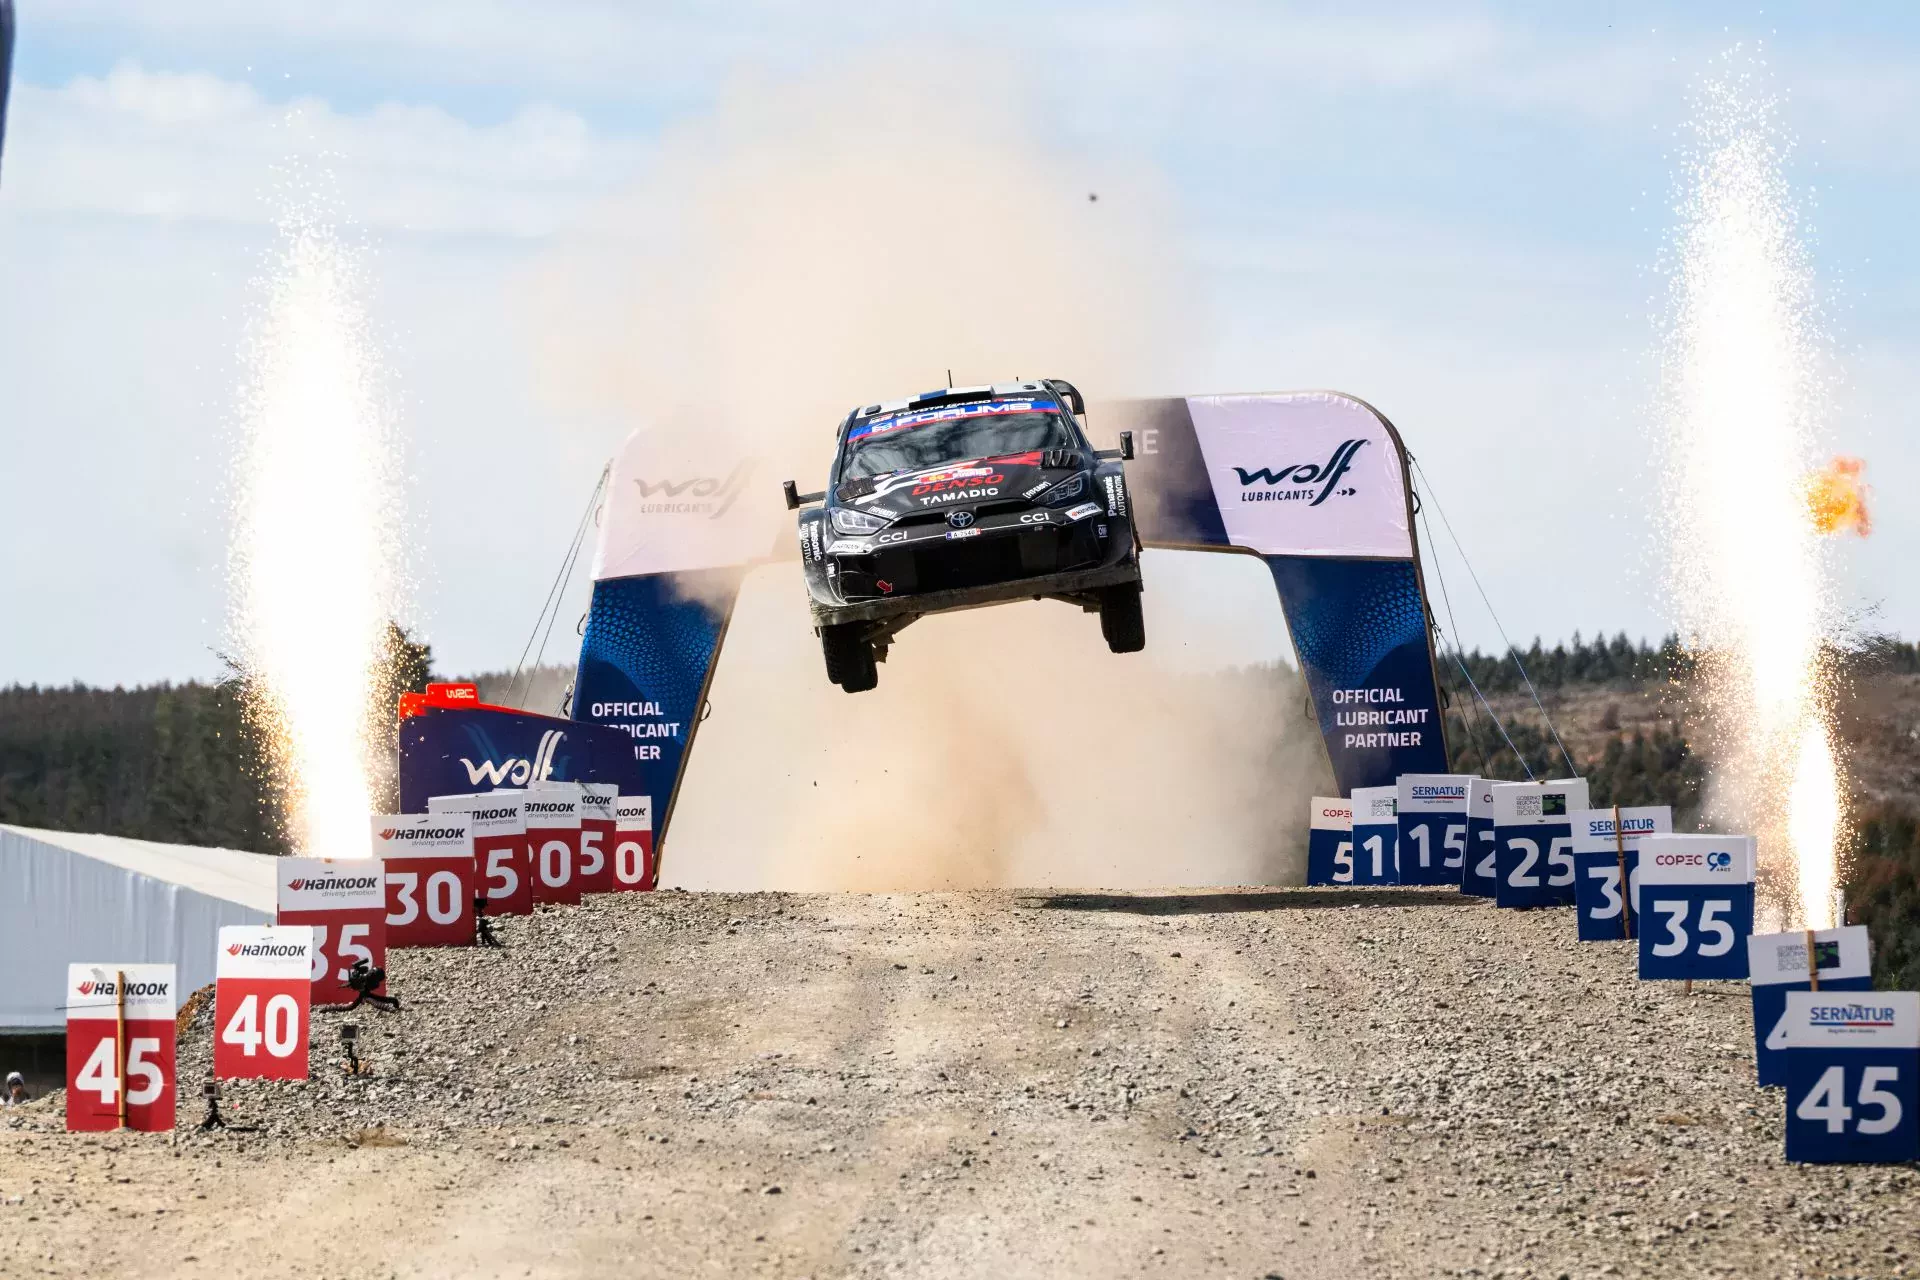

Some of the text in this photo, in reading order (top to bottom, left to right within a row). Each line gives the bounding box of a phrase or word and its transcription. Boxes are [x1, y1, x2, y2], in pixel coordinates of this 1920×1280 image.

[912, 473, 1005, 496] DENSO
[920, 487, 999, 506] TAMADIC
[1103, 475, 1117, 517] Panasonic
[1241, 489, 1315, 502] LUBRICANTS
[1020, 512, 1050, 524] CCI
[810, 520, 823, 562] Panasonic
[879, 530, 908, 543] CCI
[446, 688, 475, 699] WRC
[1332, 687, 1405, 704] OFFICIAL
[591, 701, 664, 717] OFFICIAL
[1336, 708, 1429, 727] LUBRICANT
[603, 722, 680, 738] ICANT
[1345, 731, 1422, 748] PARTNER
[1412, 785, 1465, 796] SERNATUR
[1323, 808, 1352, 819] COPE
[1589, 818, 1655, 832] SERATUR
[1408, 823, 1466, 868] 15
[1331, 841, 1353, 883] 5
[1507, 837, 1575, 888] 25
[1655, 854, 1703, 866] COPEC
[322, 890, 346, 898] driving
[385, 871, 463, 925] 30
[1652, 900, 1735, 957] 35
[1810, 1006, 1895, 1021] SERNATUR
[222, 994, 299, 1058] 40
[75, 1037, 164, 1105] 45
[1796, 1066, 1903, 1135] 45
